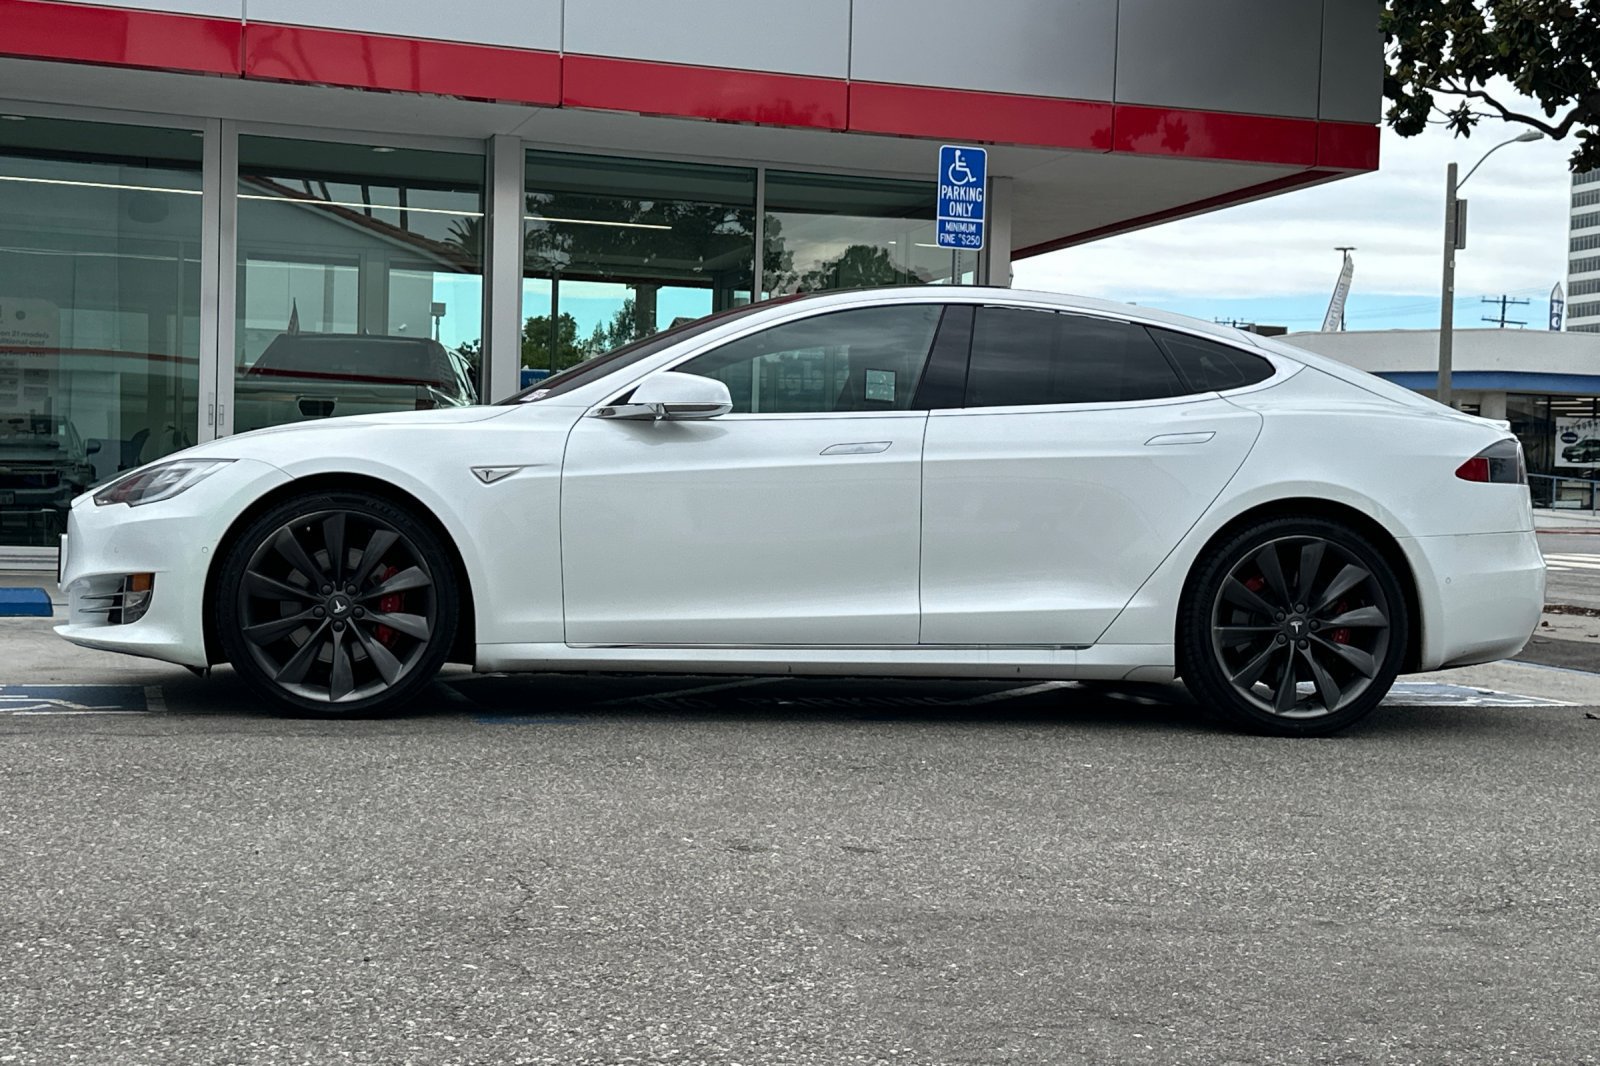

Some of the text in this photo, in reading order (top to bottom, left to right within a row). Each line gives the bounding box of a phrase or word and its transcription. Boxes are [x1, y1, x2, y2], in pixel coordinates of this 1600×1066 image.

[941, 184, 983, 202] PARKING
[948, 201, 974, 217] ONLY
[945, 221, 977, 233] MINIMUM
[940, 233, 981, 246] FINE $250
